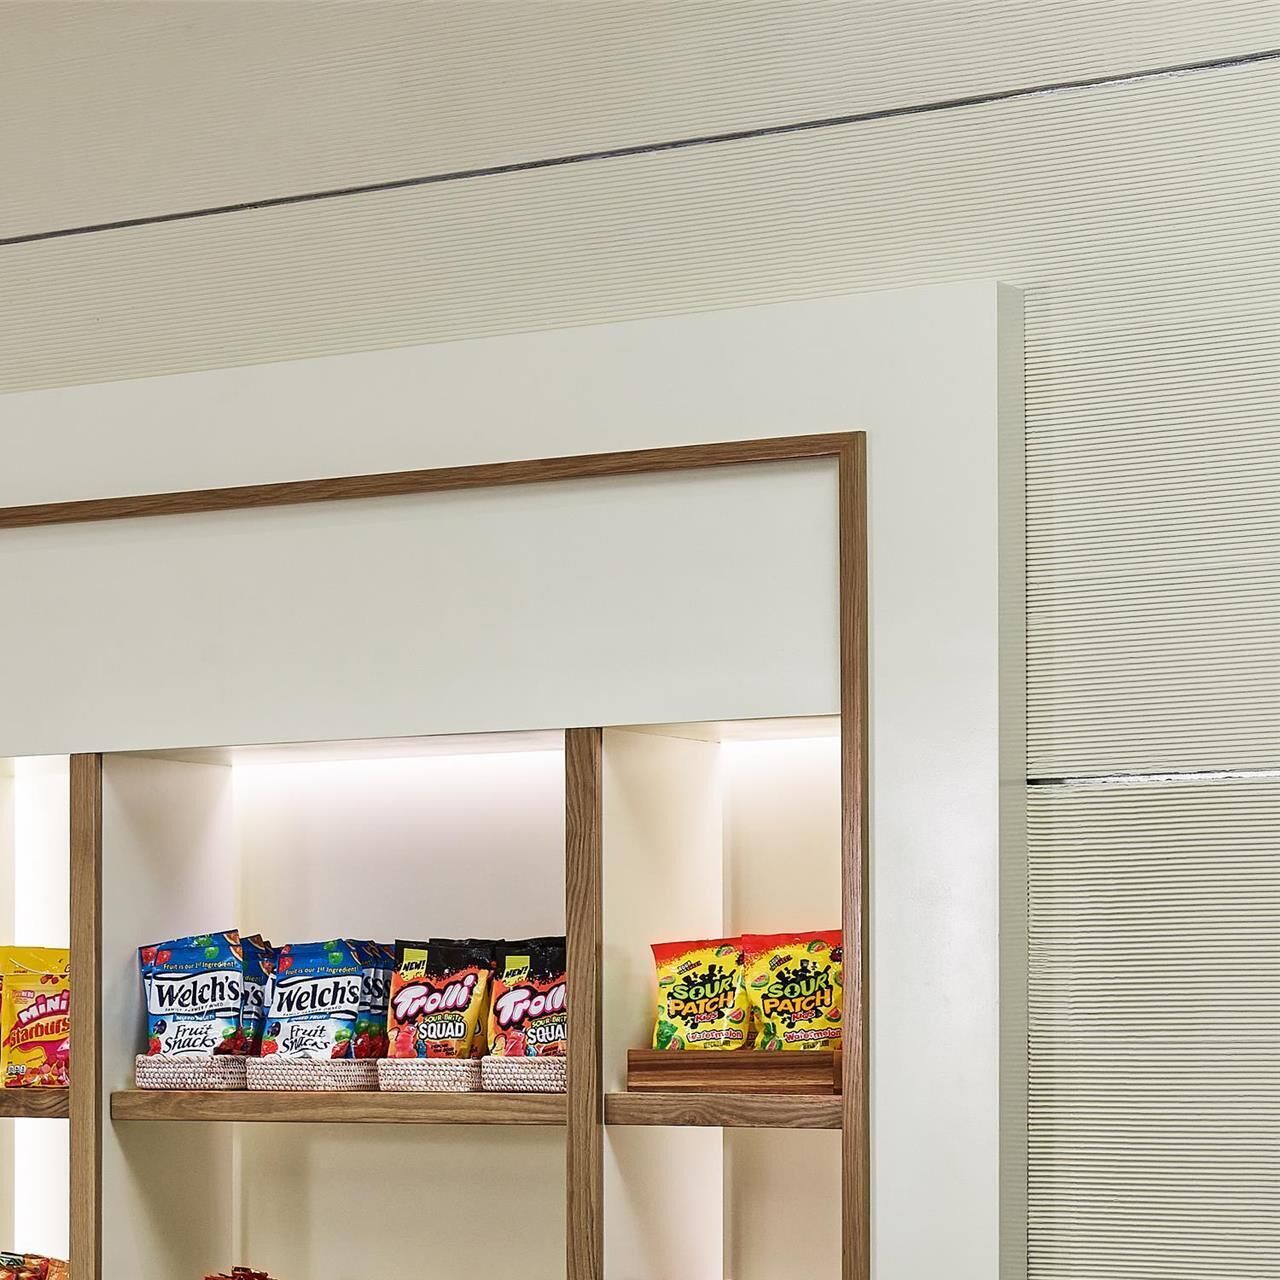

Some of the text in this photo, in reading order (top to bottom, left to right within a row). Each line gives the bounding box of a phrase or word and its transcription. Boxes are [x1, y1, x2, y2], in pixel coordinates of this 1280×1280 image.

[402, 959, 426, 972] NEW!
[505, 966, 528, 979] NEW!
[155, 975, 240, 1008] Welch's
[276, 980, 360, 1013] Welch's
[393, 974, 477, 1020] Trolli
[673, 977, 731, 1000] SOUR
[768, 976, 828, 999] SOUR
[496, 984, 567, 1027] Troll
[670, 991, 735, 1017] PATCH
[764, 989, 832, 1015] PATCH
[10, 1016, 70, 1049] Starburs
[175, 1024, 214, 1040] Fruit
[290, 1024, 327, 1040] Fruit
[419, 1021, 465, 1039] SQUAD
[162, 1035, 218, 1054] Snacks
